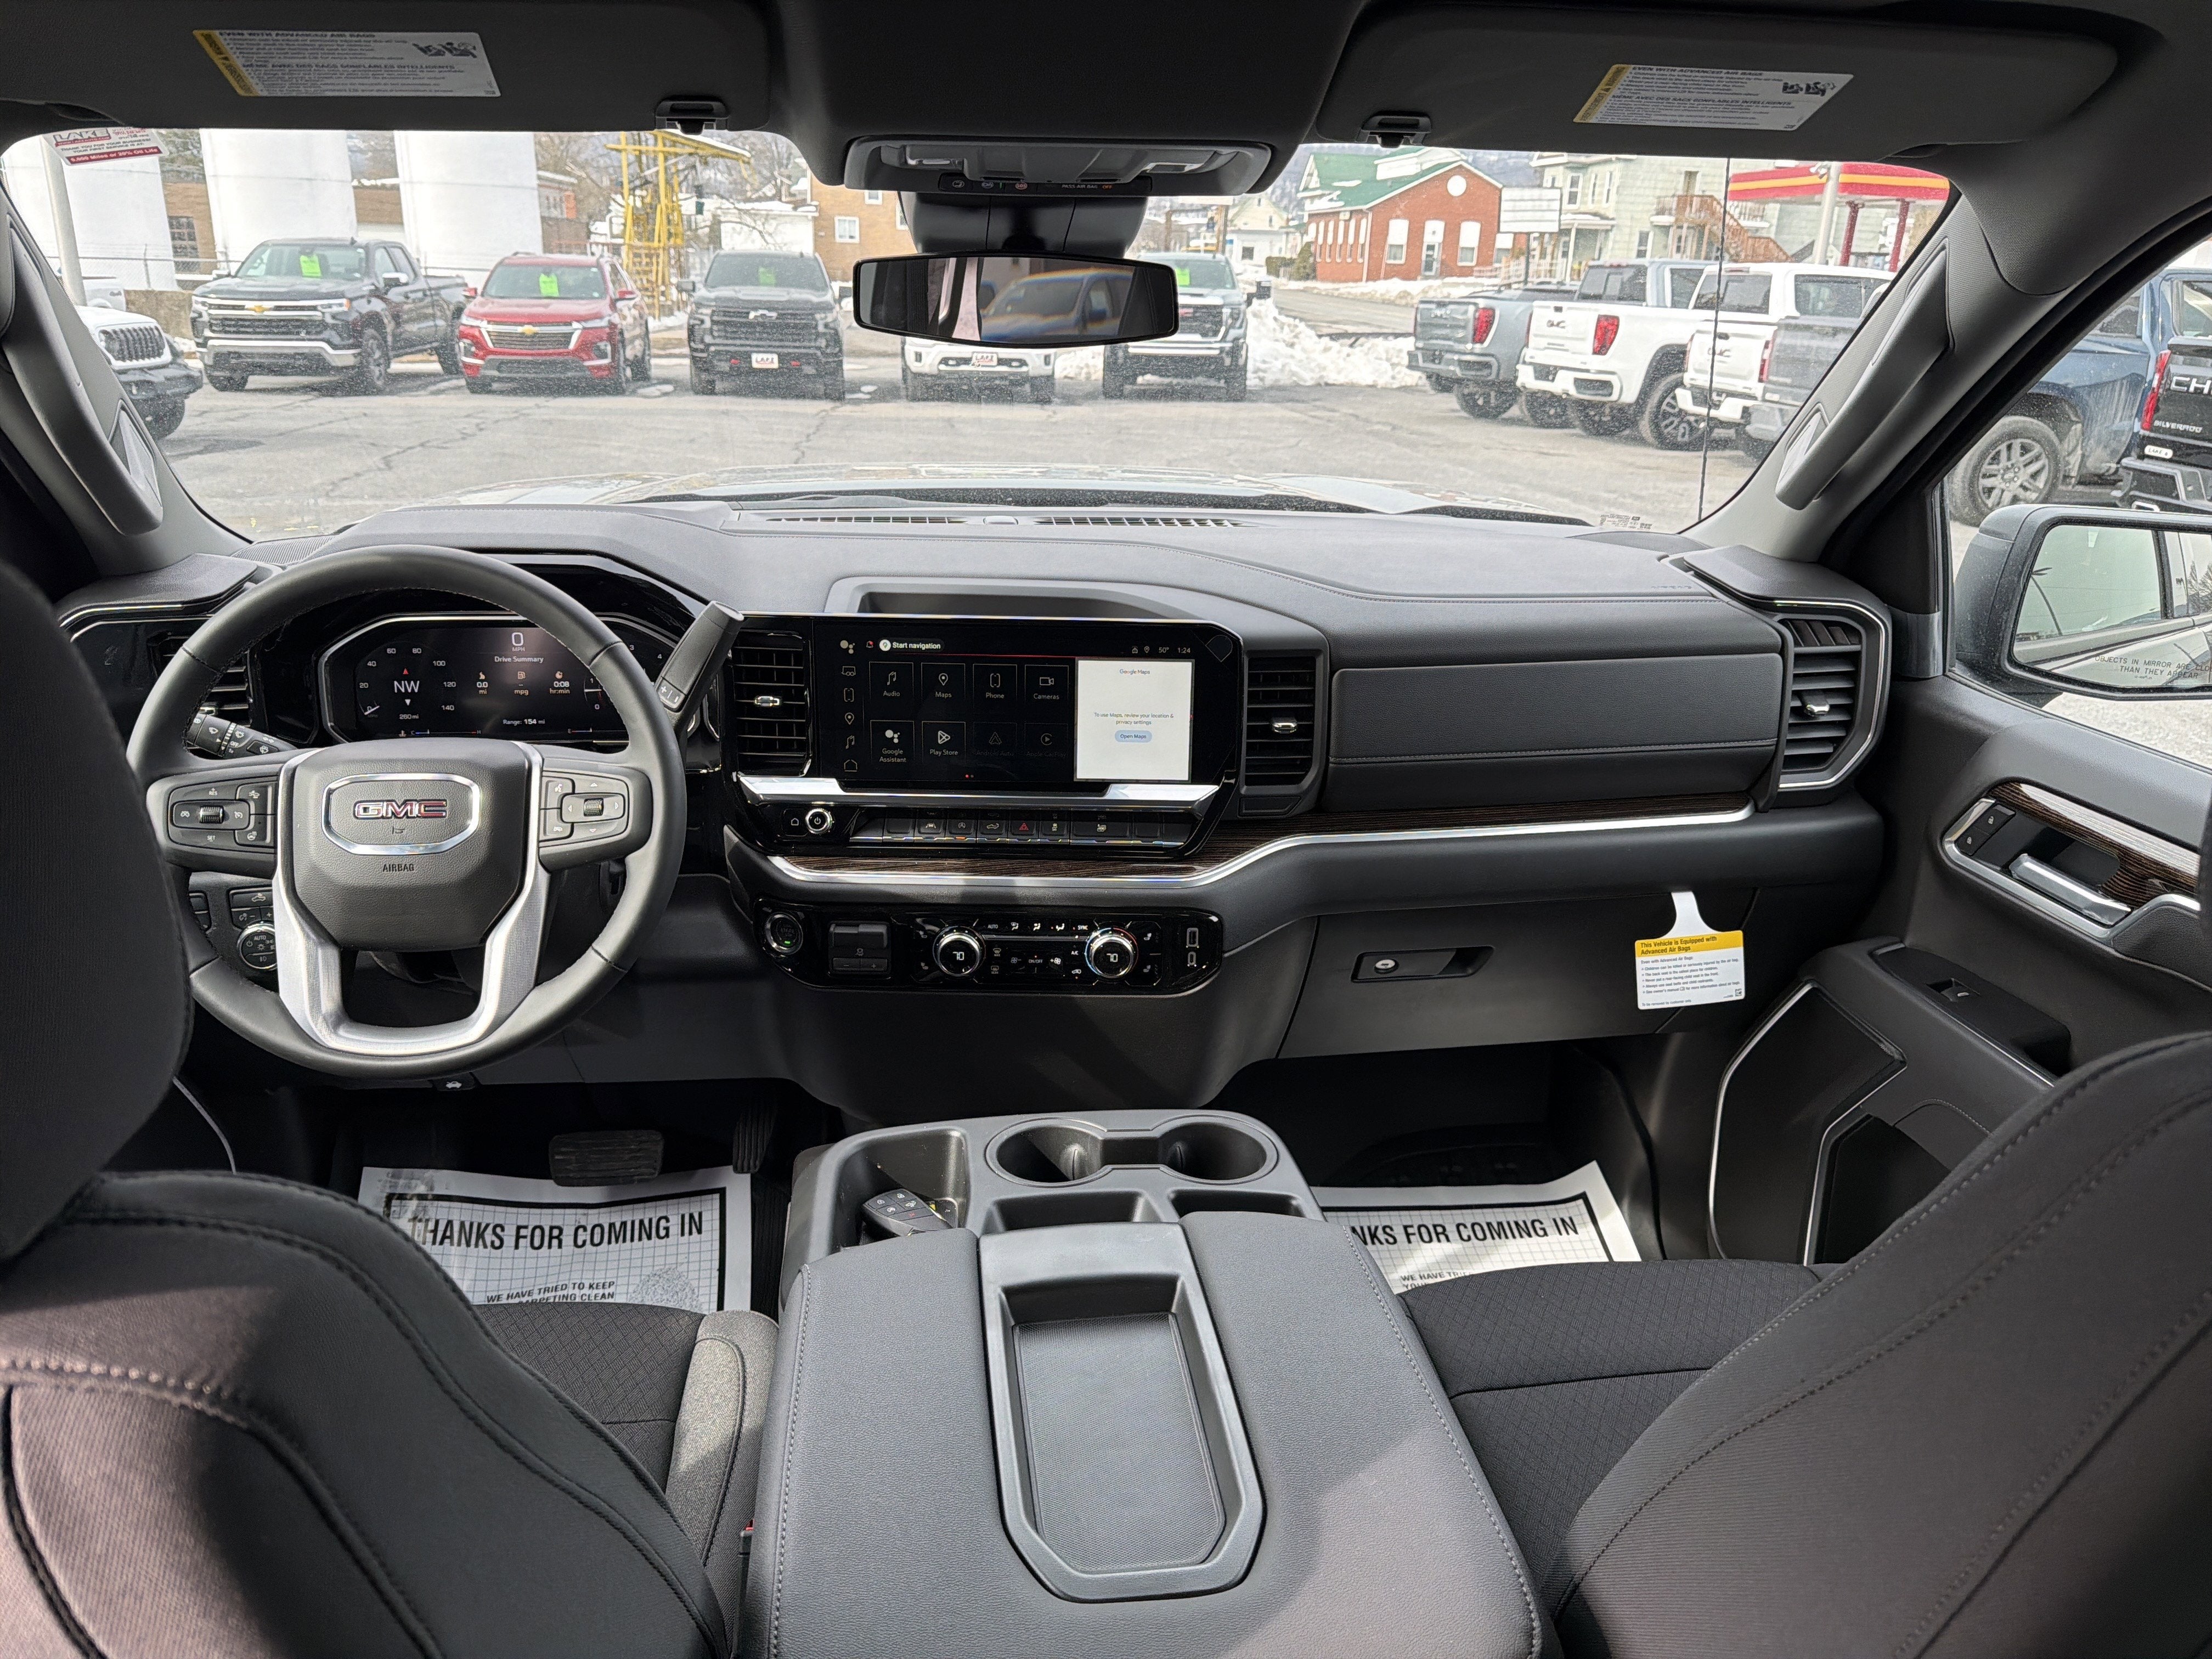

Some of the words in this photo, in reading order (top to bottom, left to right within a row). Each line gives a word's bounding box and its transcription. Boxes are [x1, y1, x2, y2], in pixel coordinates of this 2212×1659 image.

[53, 128, 110, 142] LAKE
[511, 632, 524, 646] 0
[909, 642, 941, 651] navigation
[2095, 656, 2128, 664] OBJECTS
[2143, 659, 2172, 668] MIRROR
[2167, 670, 2199, 679] APPEAR
[394, 680, 420, 693] NW
[354, 799, 448, 819] GMC
[382, 862, 415, 873] AIRBAG
[952, 952, 964, 961] 70
[1106, 953, 1118, 962] 70
[408, 1215, 505, 1250] THANKS
[514, 1224, 563, 1250] FOR
[573, 1215, 671, 1249] COMING
[680, 1211, 703, 1237] IN
[1402, 1223, 1452, 1244] FOR
[1455, 1218, 1549, 1242] COMING
[1552, 1216, 1579, 1237] IN
[1419, 1272, 1446, 1280] HAVE
[487, 1295, 503, 1304] WE
[506, 1289, 534, 1300] HAVE
[537, 1283, 567, 1295] TRIED
[572, 1282, 585, 1290] TO
[589, 1281, 615, 1290] KEEP
[518, 1293, 577, 1304] RPETING
[580, 1291, 614, 1301] CLEAN
